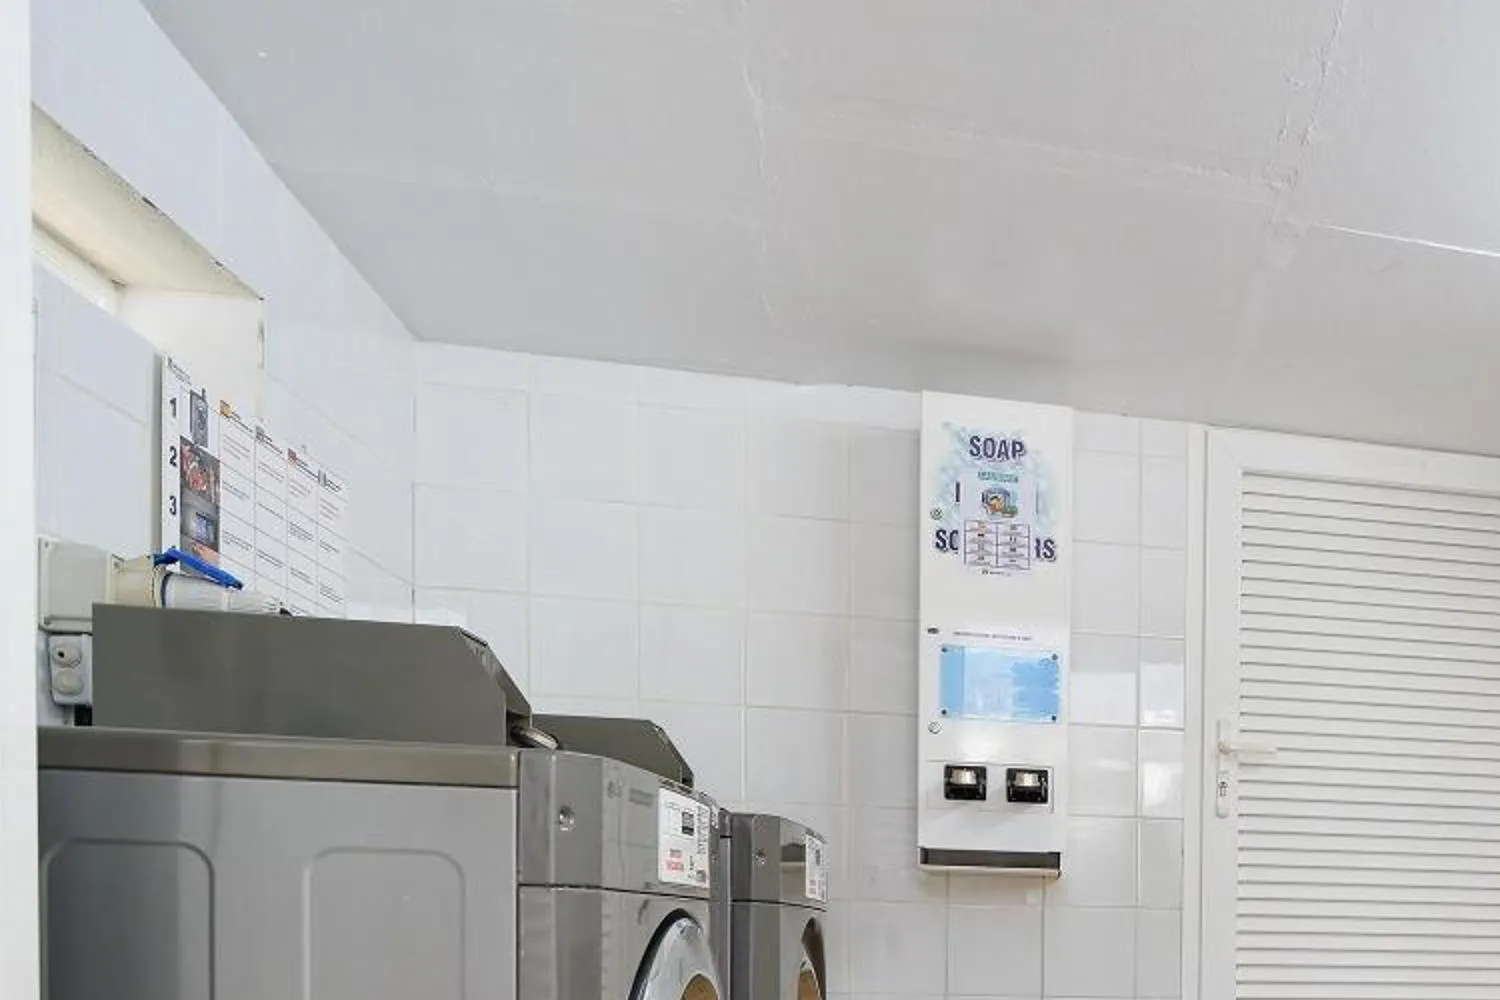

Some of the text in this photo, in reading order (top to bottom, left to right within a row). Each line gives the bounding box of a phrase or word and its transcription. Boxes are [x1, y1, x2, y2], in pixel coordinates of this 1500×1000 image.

[169, 397, 177, 418] 1
[169, 445, 178, 468] 2
[968, 435, 1026, 460] SOAP
[169, 495, 177, 516] 3
